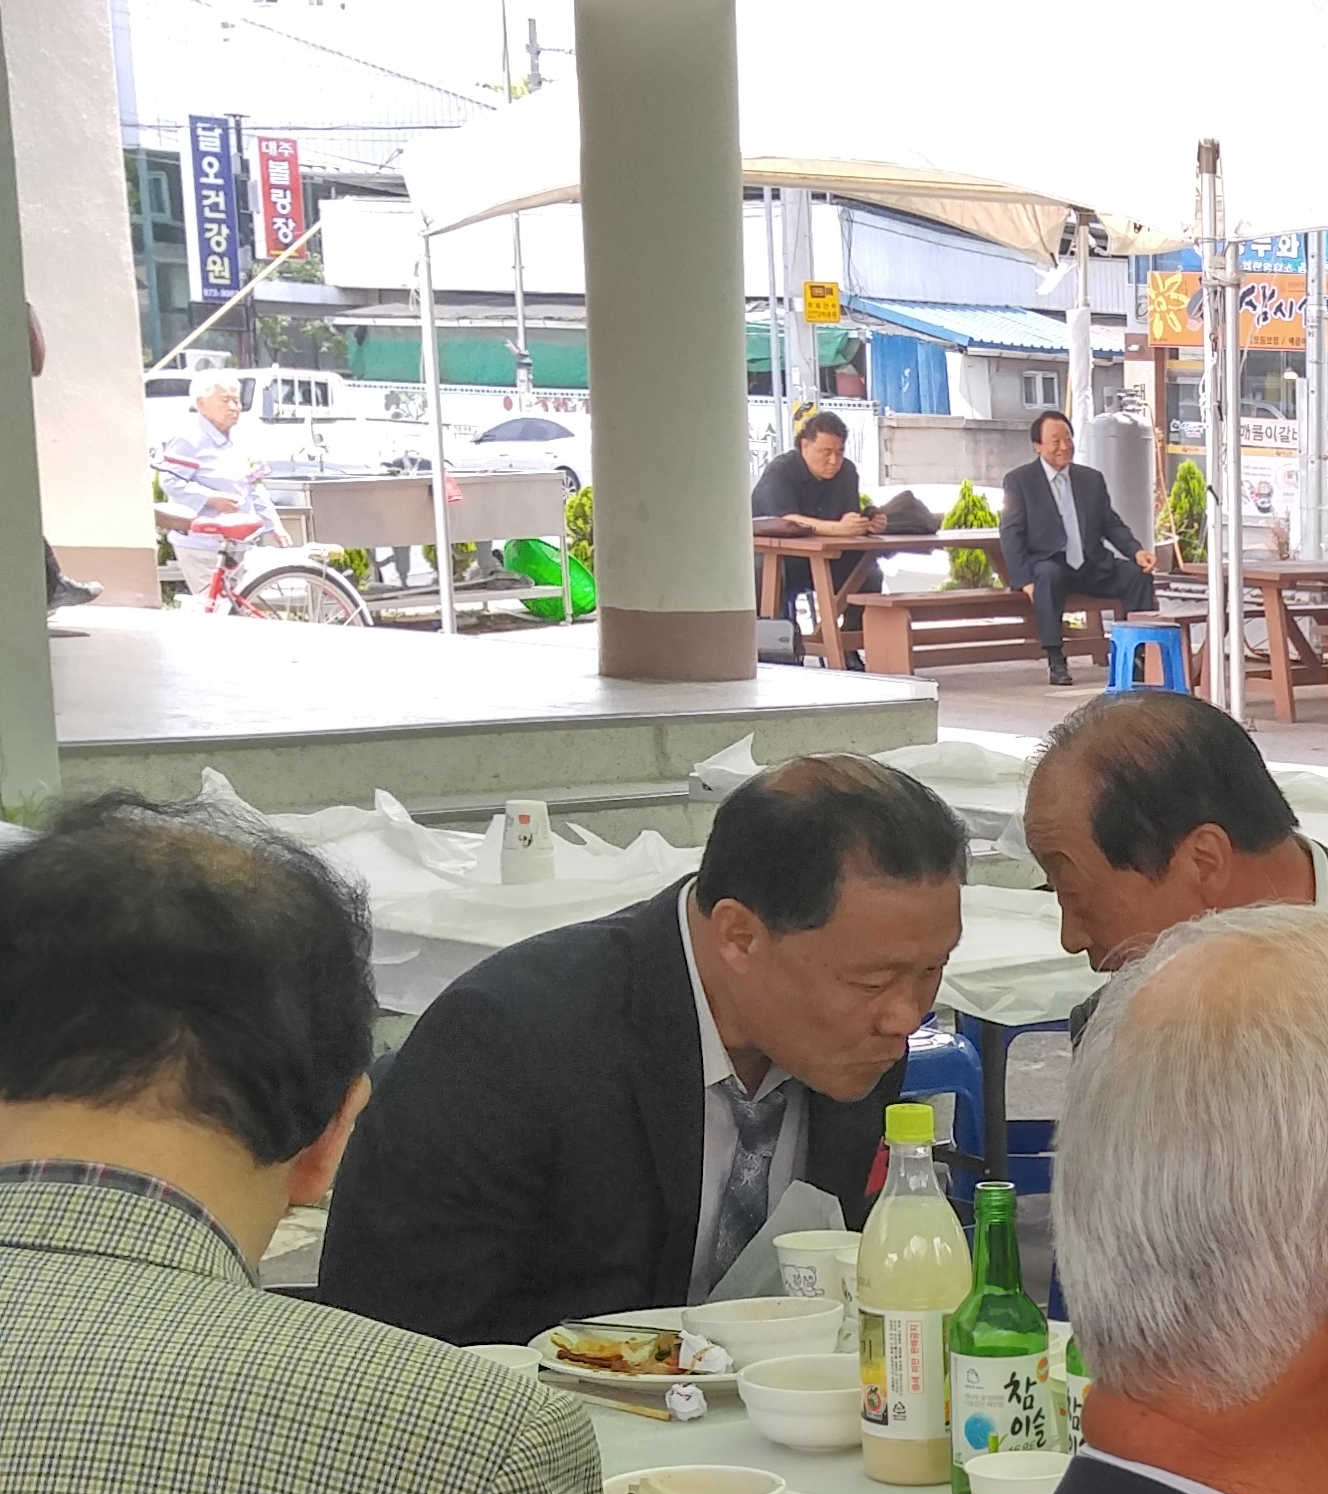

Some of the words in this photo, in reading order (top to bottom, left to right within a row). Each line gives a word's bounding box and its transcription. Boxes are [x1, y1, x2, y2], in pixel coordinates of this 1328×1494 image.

[268, 159, 296, 244] 볼링장
[1003, 1371, 1037, 1411] 참
[1010, 1407, 1047, 1448] 이슬
